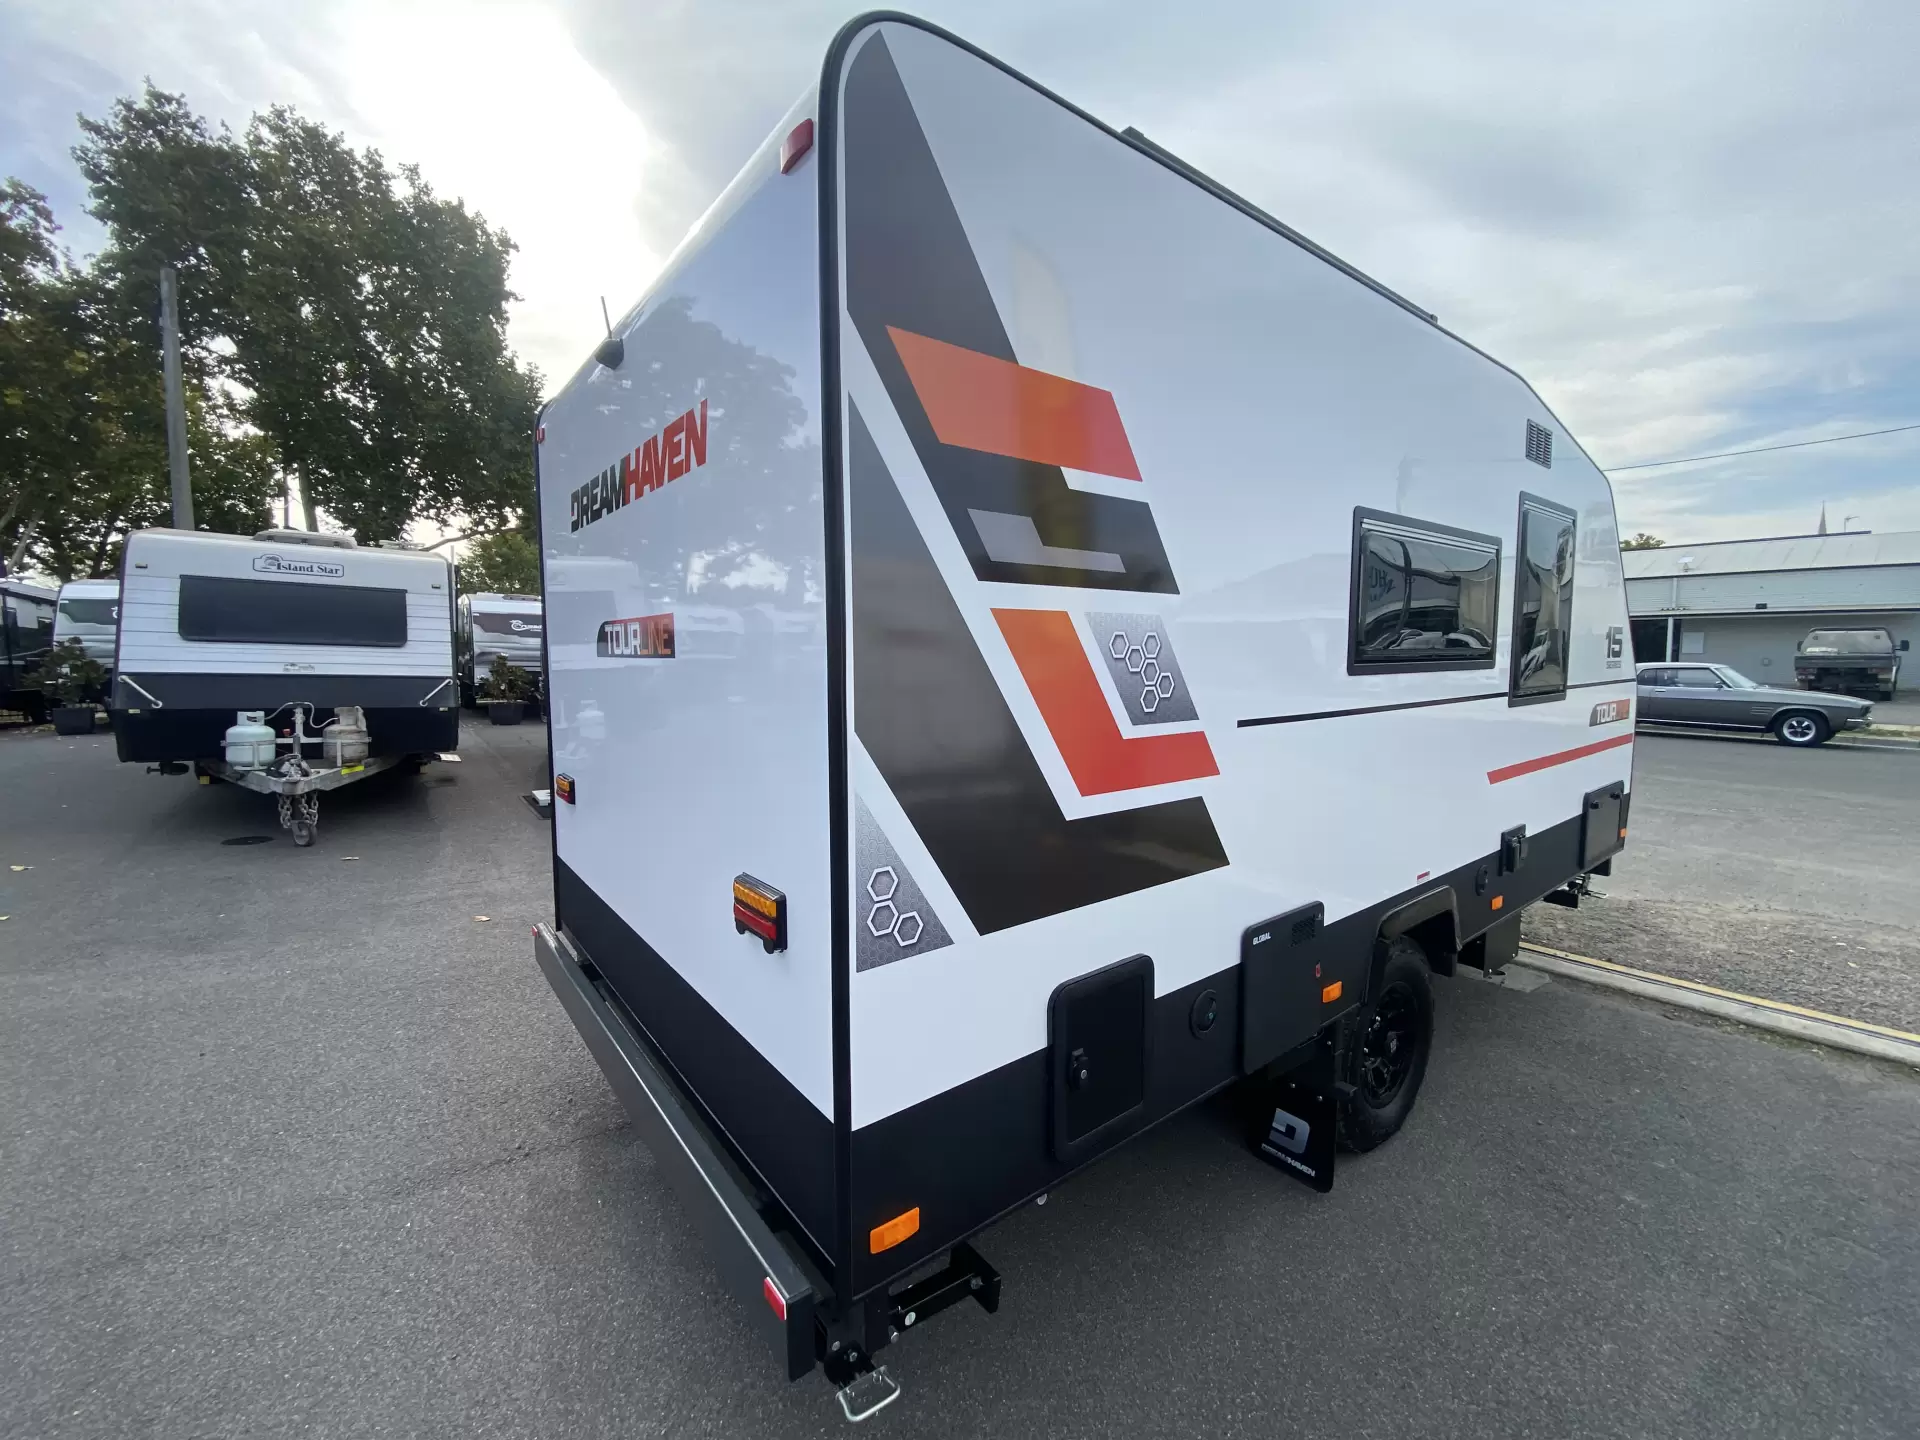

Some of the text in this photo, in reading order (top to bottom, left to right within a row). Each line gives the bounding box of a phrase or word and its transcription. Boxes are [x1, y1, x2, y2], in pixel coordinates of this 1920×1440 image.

[570, 397, 708, 534] DREAMHAVEN
[276, 562, 340, 574] Island Star
[605, 619, 672, 655] TOURLINE
[1605, 626, 1623, 659] 15
[1252, 931, 1272, 946] GLOBAL
